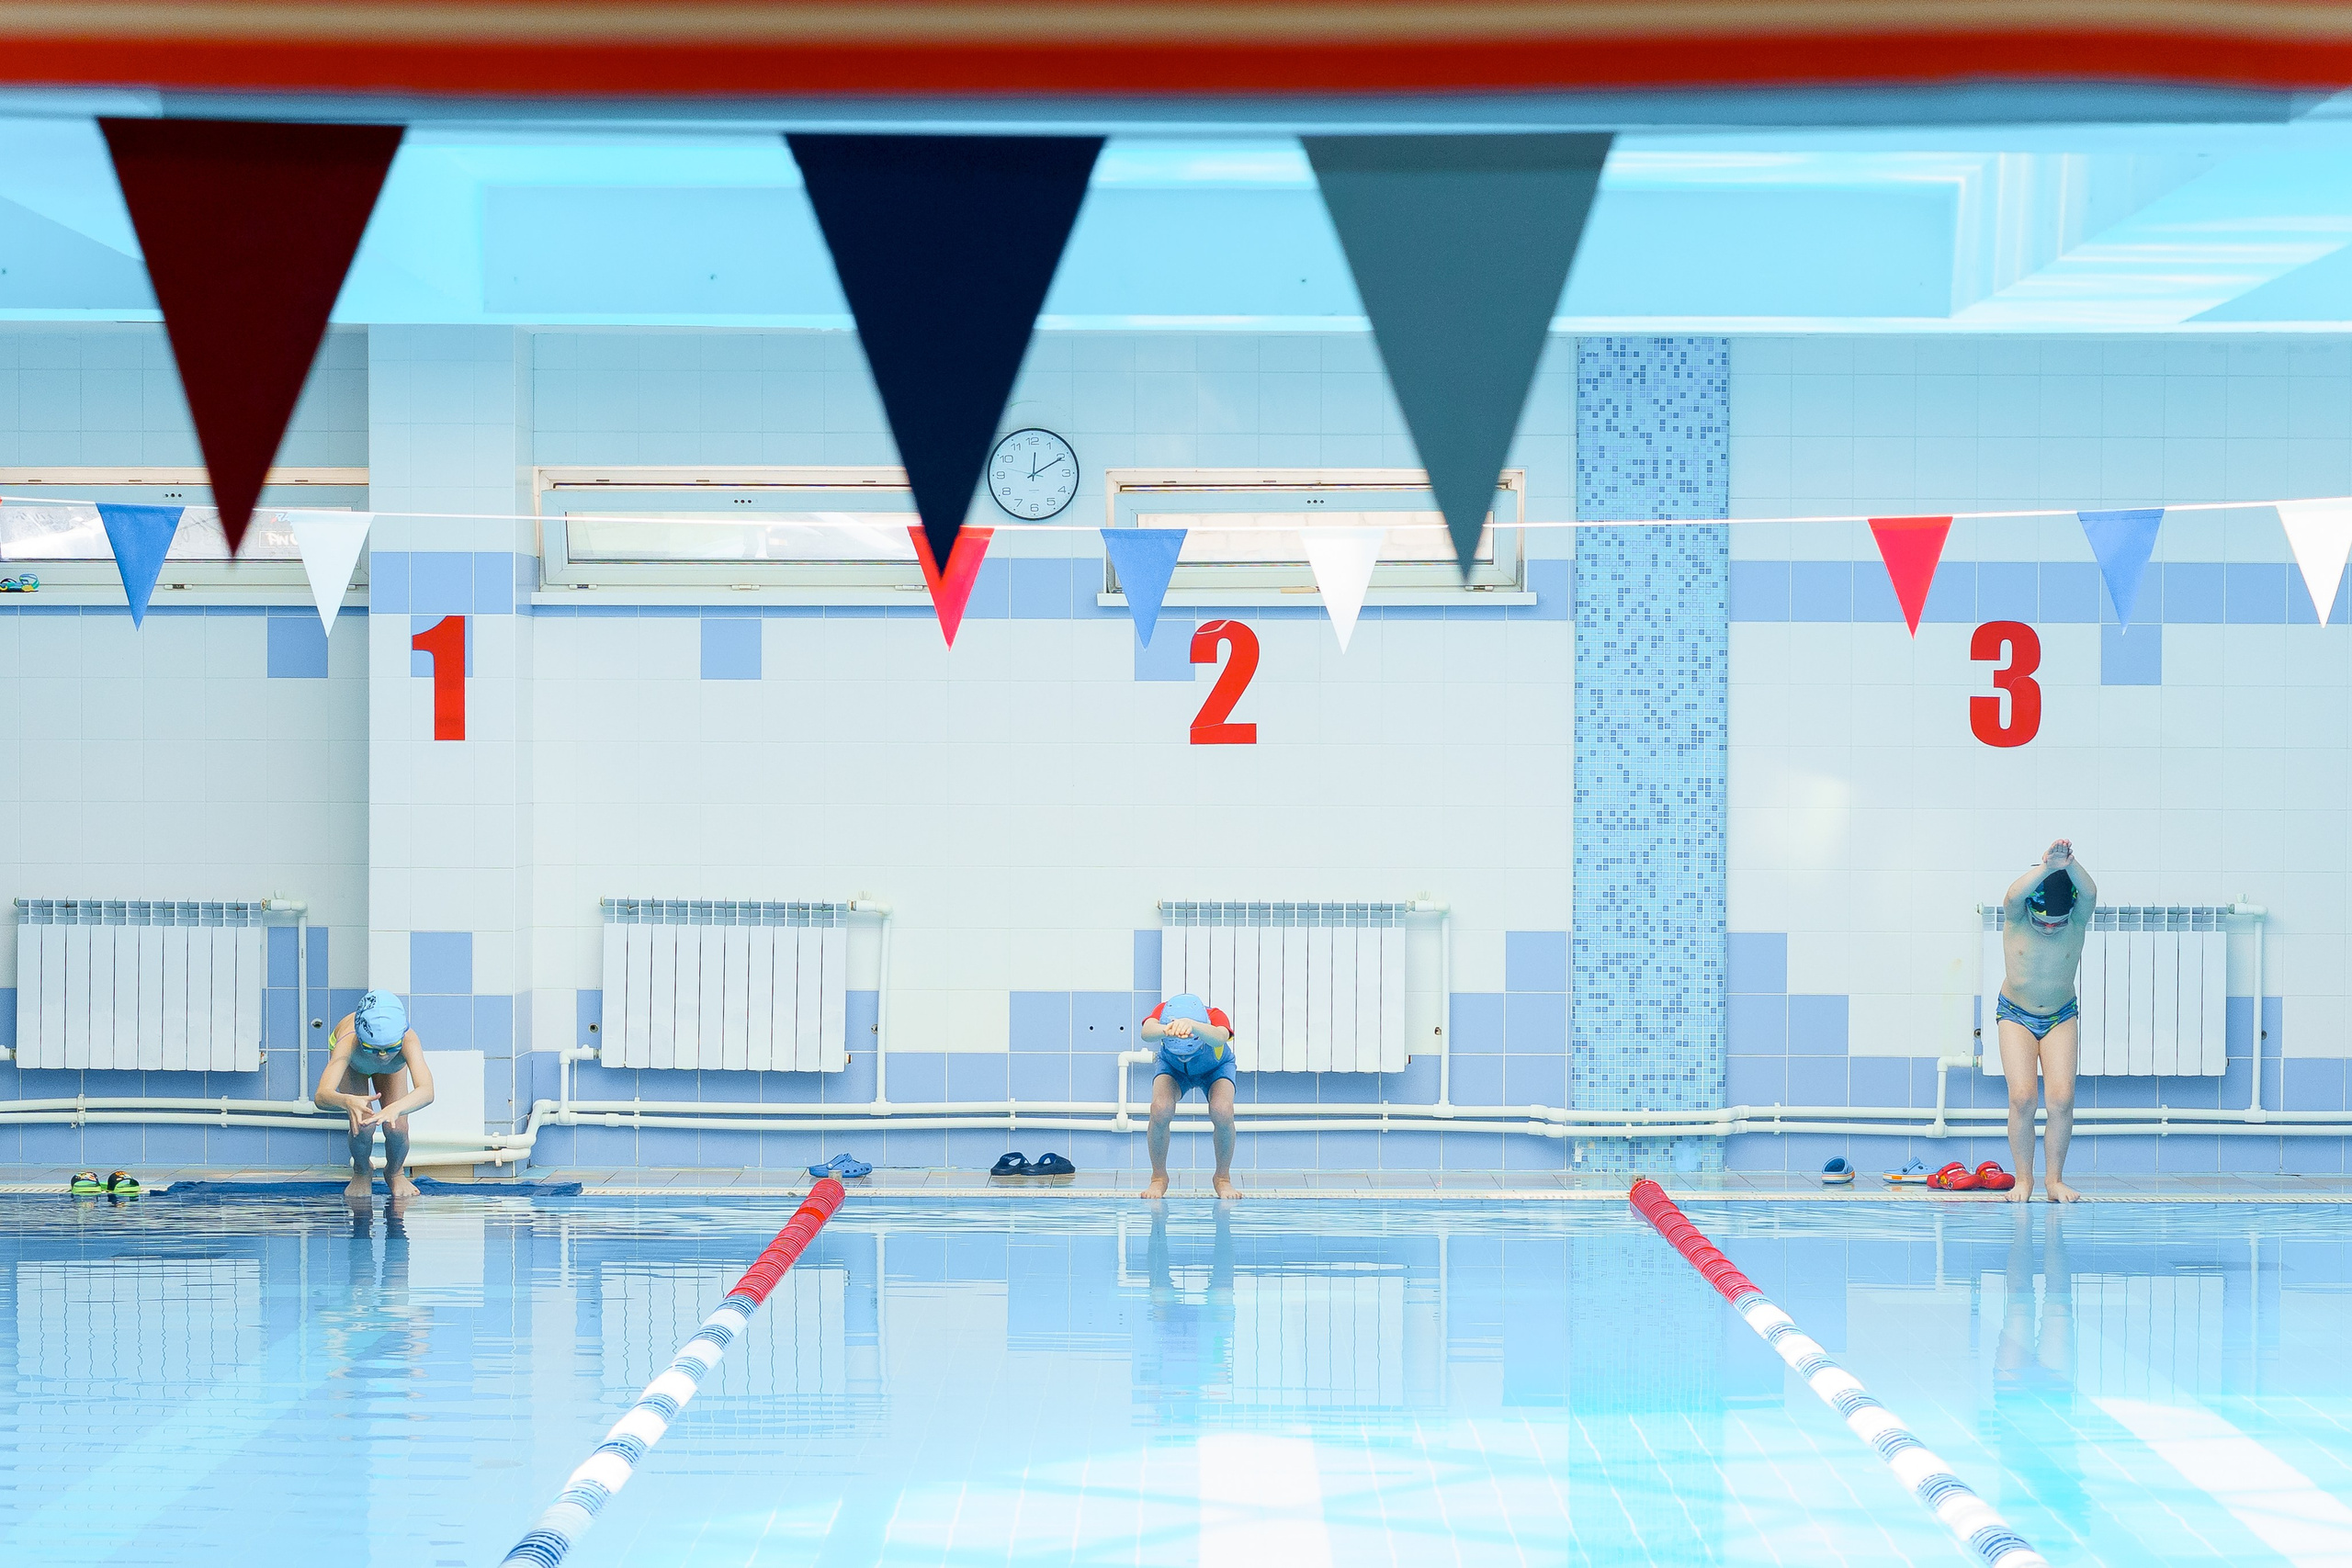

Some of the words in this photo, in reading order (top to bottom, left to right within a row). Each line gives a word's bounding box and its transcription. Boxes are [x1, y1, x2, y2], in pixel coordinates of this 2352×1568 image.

[1025, 437, 1039, 446] 12
[1011, 443, 1021, 451] 11
[1046, 442, 1052, 450] 1
[1000, 455, 1013, 463] 10
[1057, 453, 1066, 461] 2
[997, 471, 1005, 479] 9
[1002, 487, 1011, 495] 8
[1014, 499, 1023, 507] 7
[412, 615, 466, 740] 1
[1190, 620, 1260, 745] 2
[1970, 621, 2041, 748] 3
